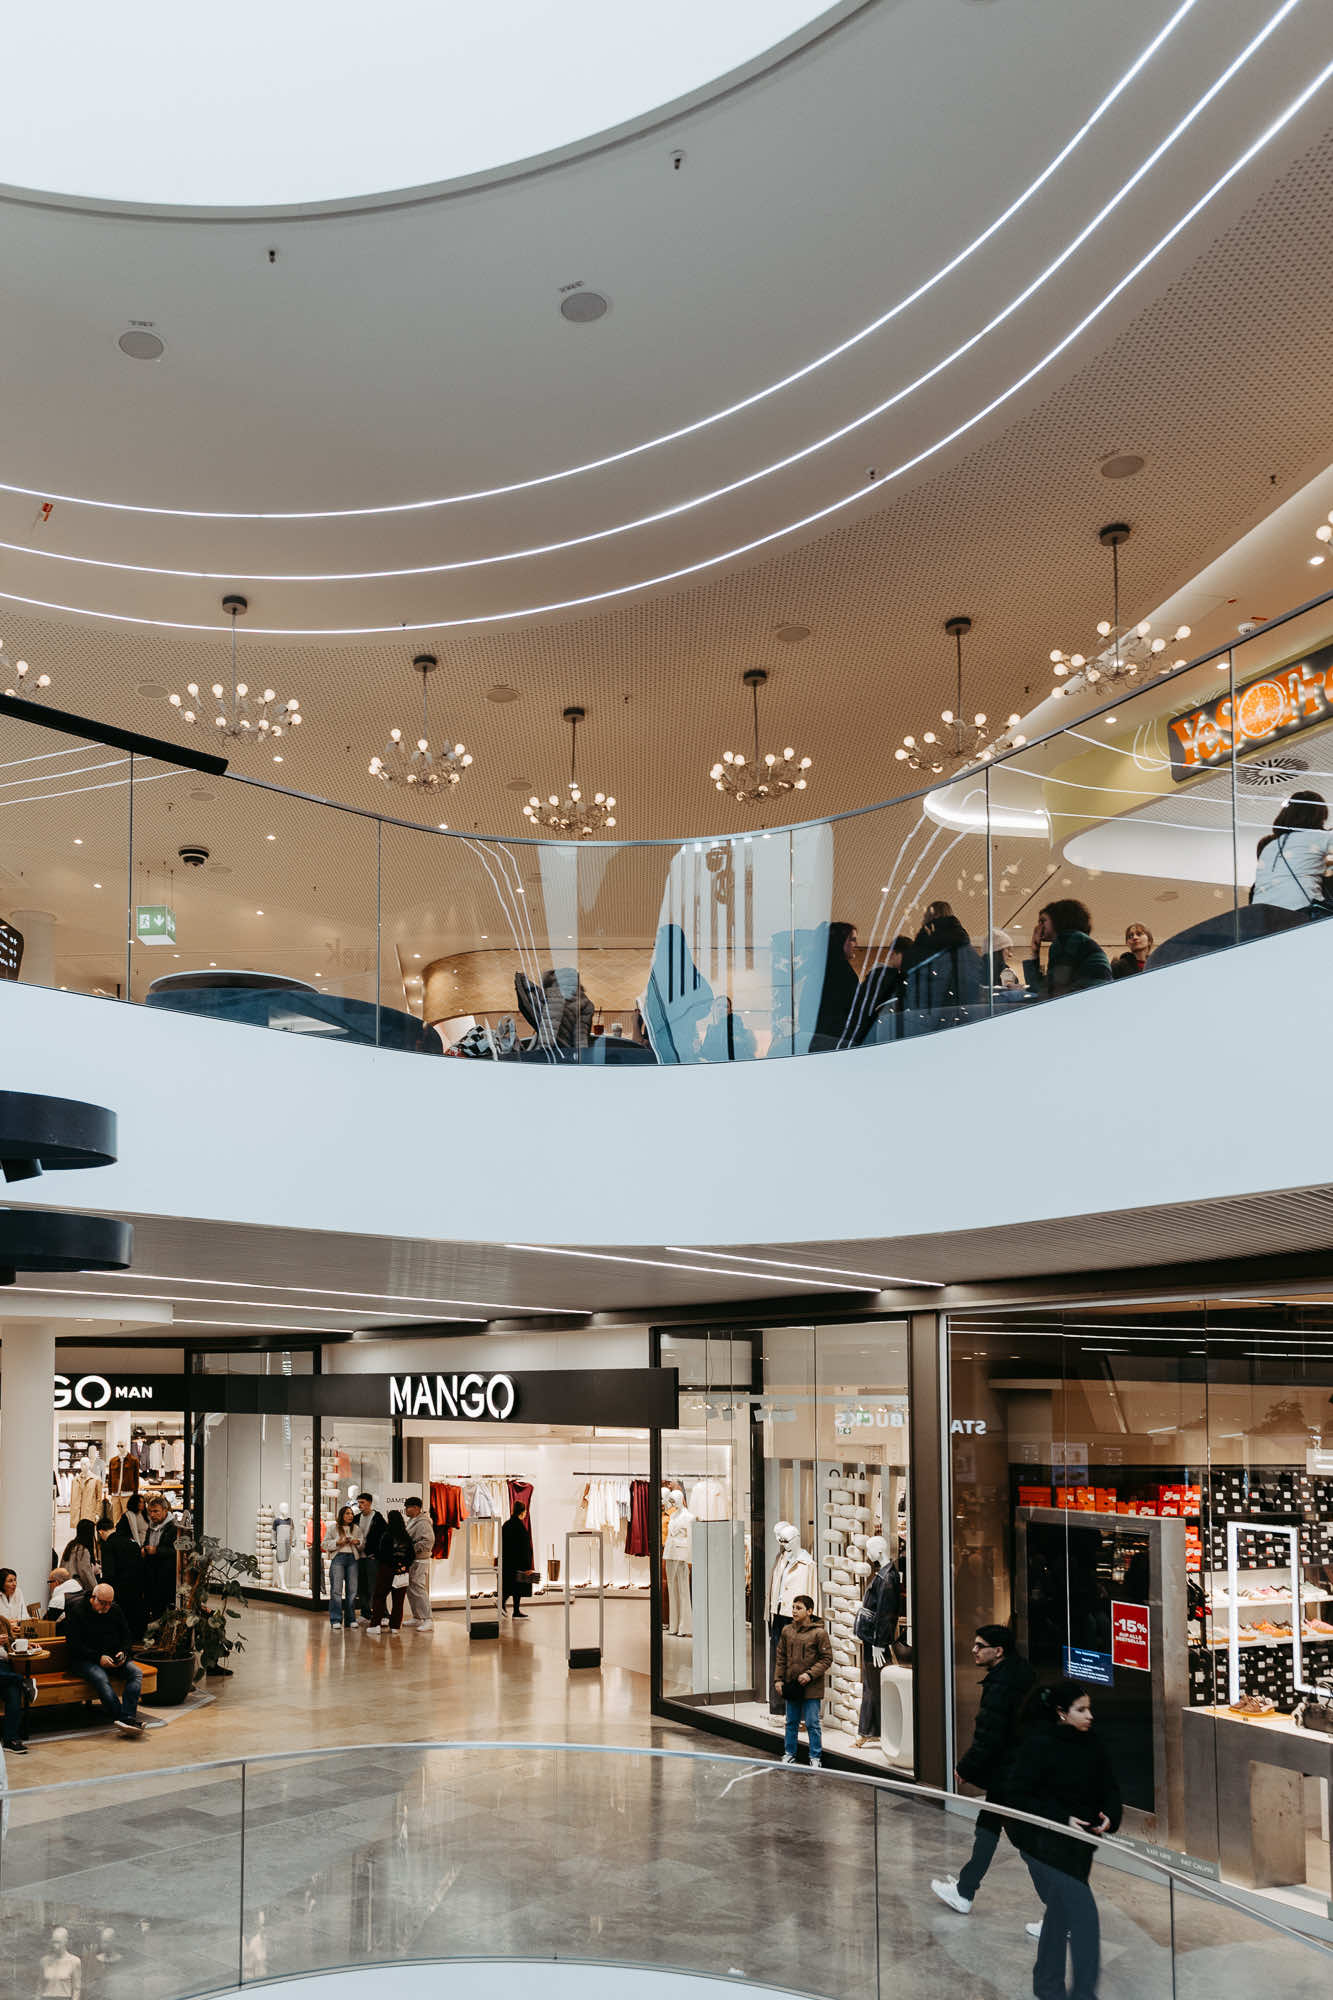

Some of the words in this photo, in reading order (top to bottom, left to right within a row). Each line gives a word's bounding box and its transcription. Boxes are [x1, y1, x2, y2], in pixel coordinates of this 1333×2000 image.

[115, 1386, 153, 1399] MAN
[389, 1373, 515, 1420] MANGO
[1114, 1618, 1148, 1634] -15%
